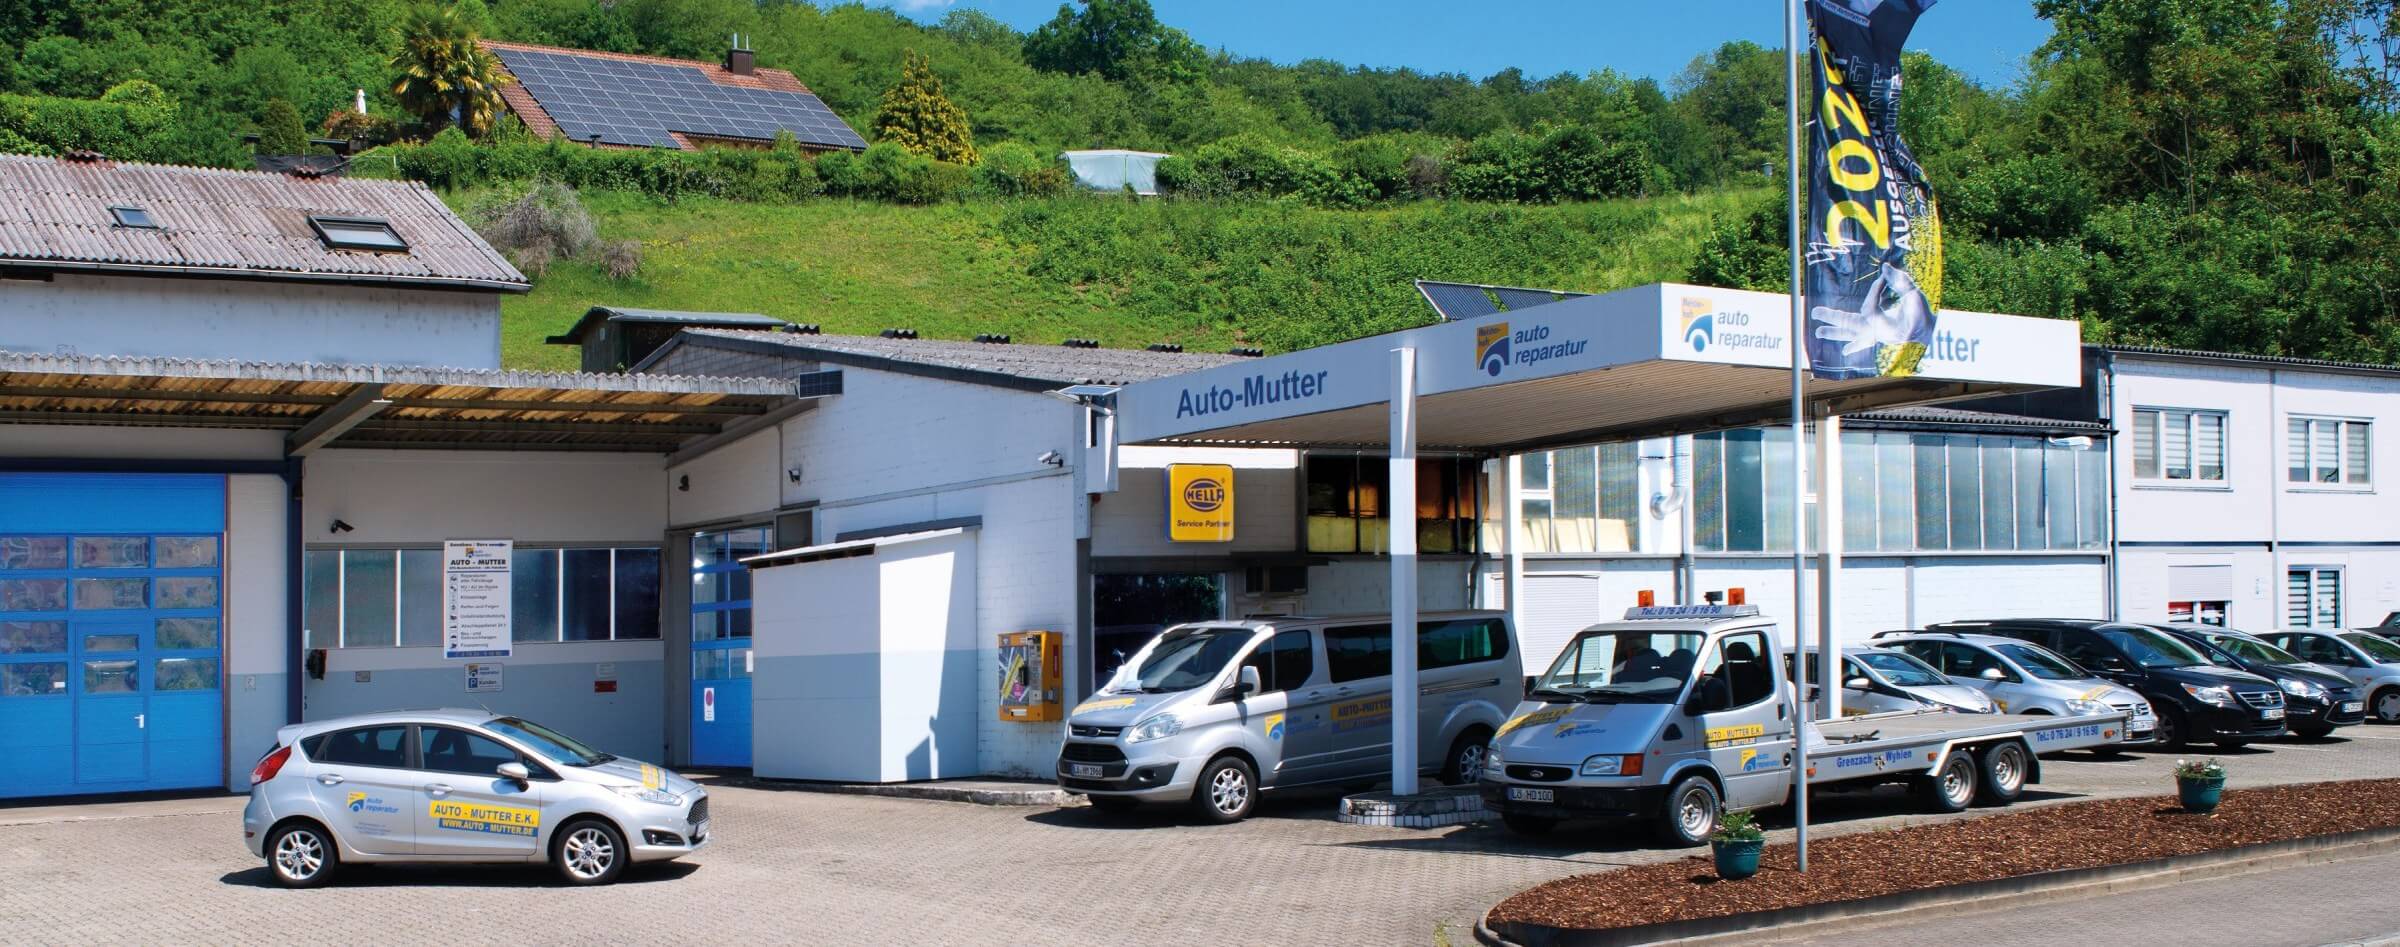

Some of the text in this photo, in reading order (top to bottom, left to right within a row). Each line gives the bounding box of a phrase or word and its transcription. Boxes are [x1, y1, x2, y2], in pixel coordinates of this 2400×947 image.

[1717, 309, 1749, 326] auto
[1514, 324, 1550, 345] auto
[1718, 331, 1782, 350] reparatur
[1514, 338, 1588, 366] reparatur
[1176, 369, 1328, 419] Auto-Mutter
[1187, 488, 1225, 503] HELLA
[1176, 519, 1203, 527] Service
[1205, 519, 1231, 528] Partner
[1837, 753, 1873, 768] Grenzach
[1885, 750, 1913, 763] Wyhlen
[434, 804, 462, 817] AUTO
[470, 808, 513, 822] MUTTER
[514, 812, 535, 824] E.K.
